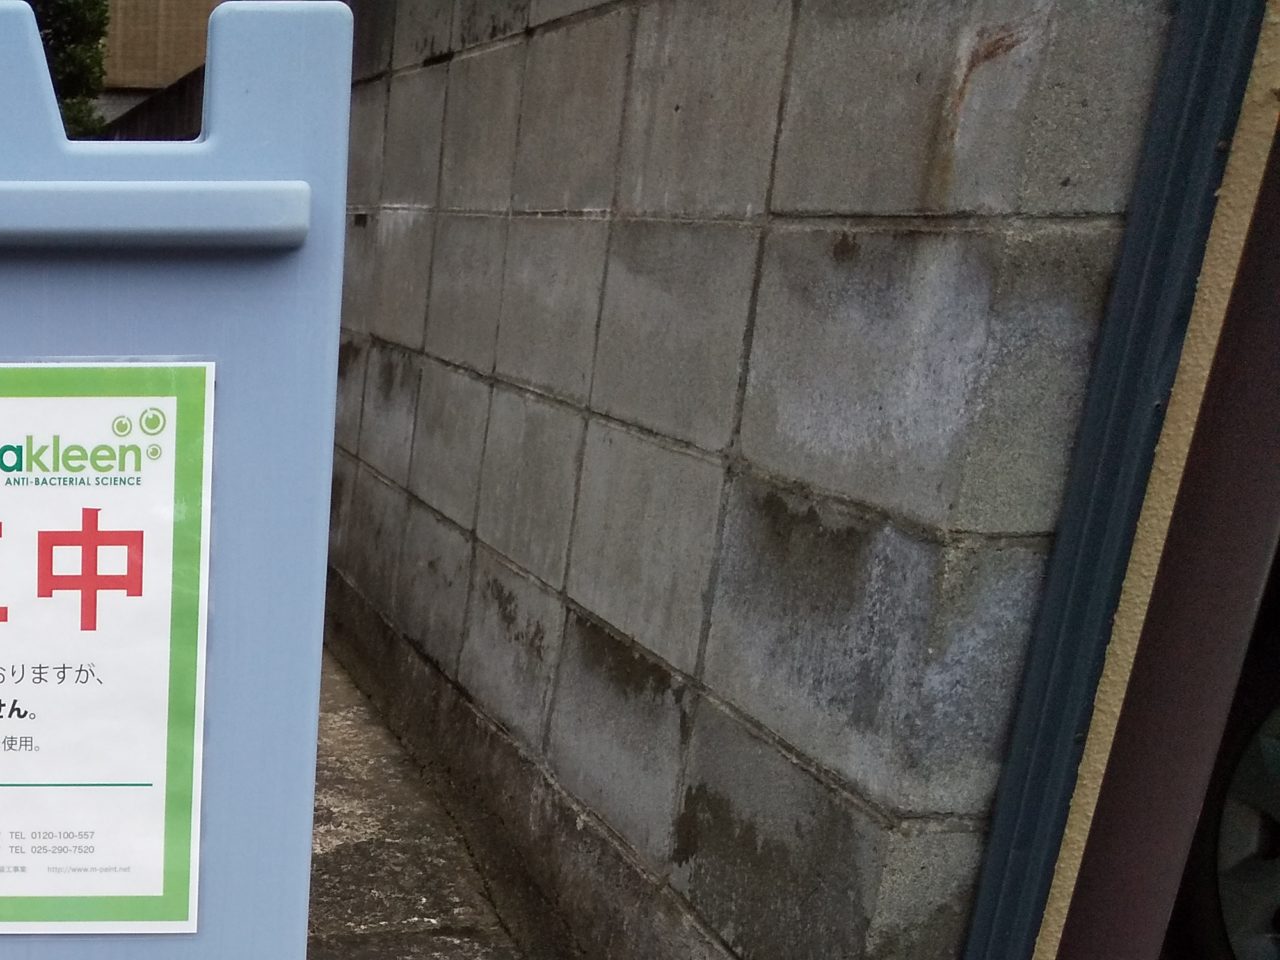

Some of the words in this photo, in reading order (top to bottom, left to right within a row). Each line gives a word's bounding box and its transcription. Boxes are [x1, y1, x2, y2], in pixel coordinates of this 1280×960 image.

[4, 476, 92, 487] ANTI-BACTERIAL
[94, 476, 142, 487] SCIENCE
[9, 831, 26, 840] TEL
[30, 831, 96, 840] 0120-100-557
[8, 845, 26, 855] TEL
[30, 845, 95, 855] 025-290-7520
